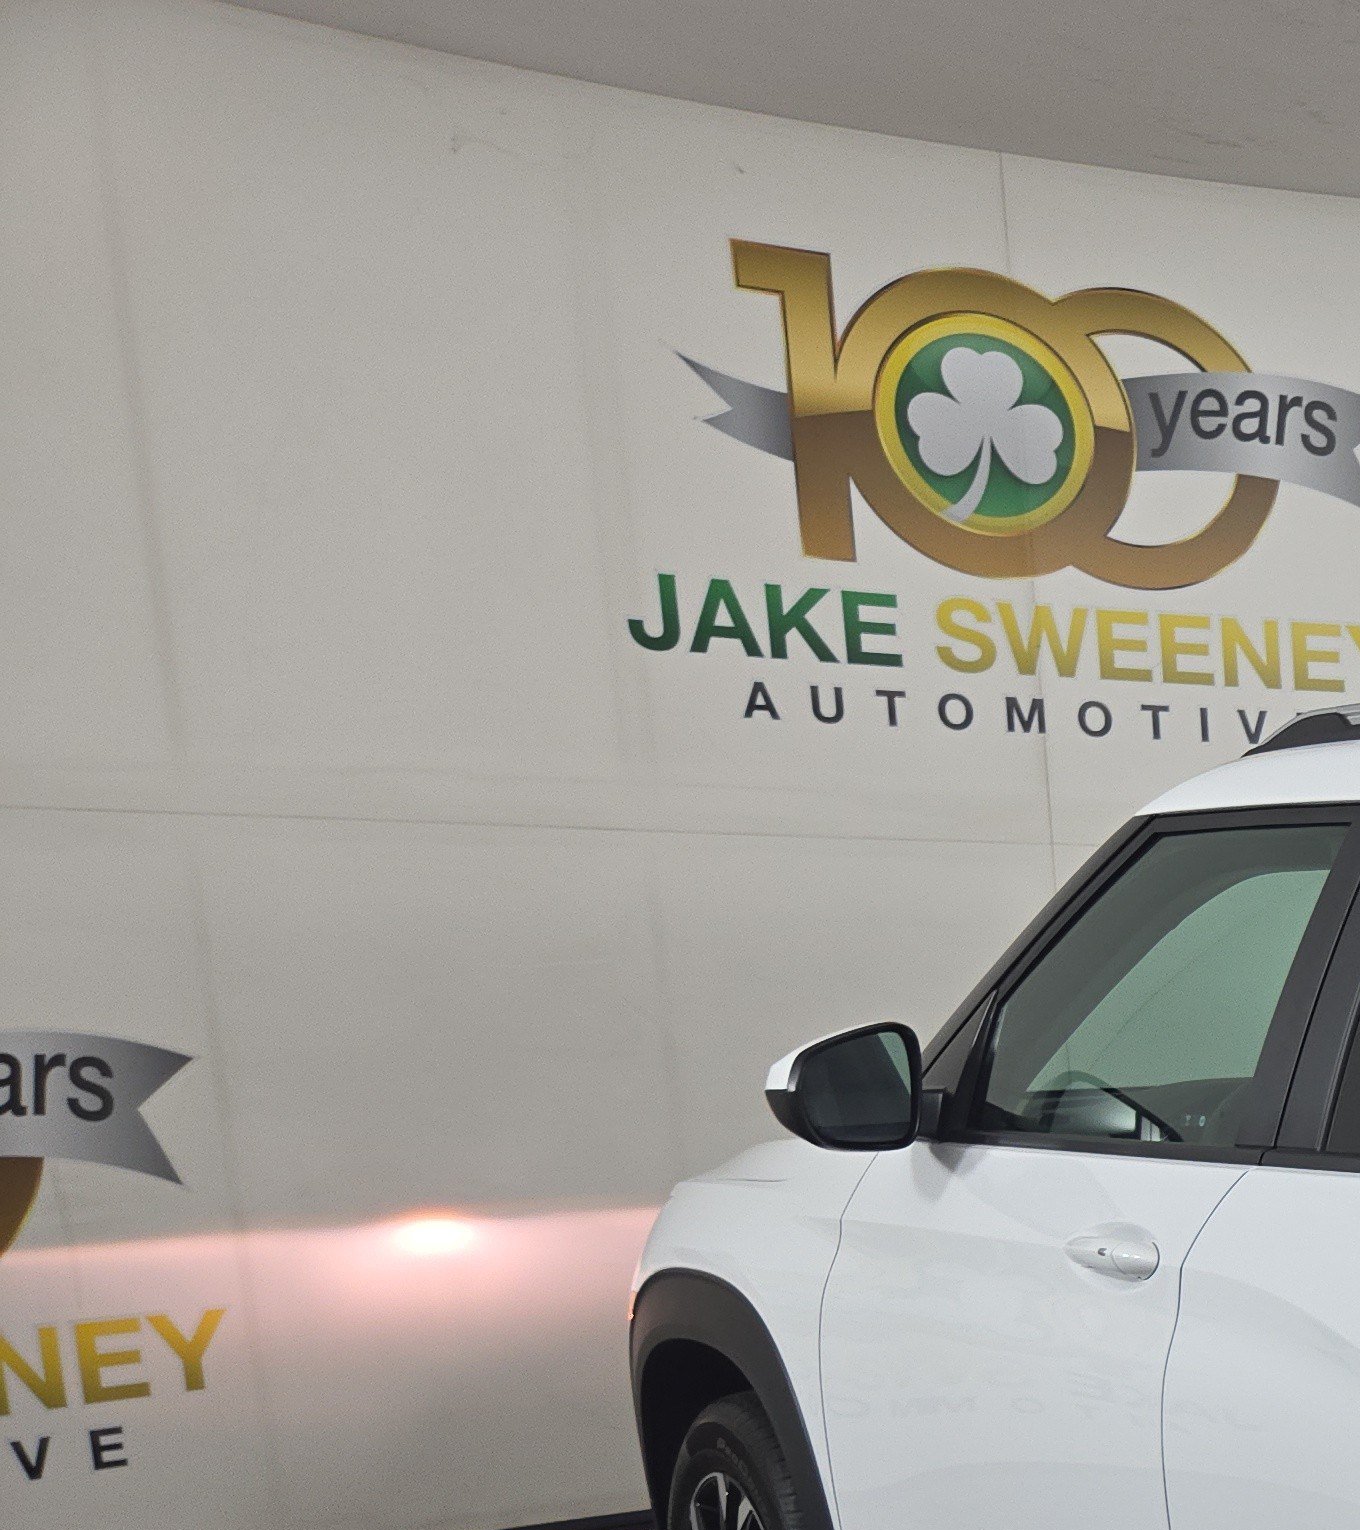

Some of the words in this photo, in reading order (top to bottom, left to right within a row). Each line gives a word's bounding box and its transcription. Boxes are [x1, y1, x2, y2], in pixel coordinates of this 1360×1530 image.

[729, 238, 1279, 590] 100
[1148, 387, 1338, 459] years
[628, 573, 904, 668] JAKE
[743, 681, 1306, 745] AUTOMOTIV
[11, 1426, 128, 1480] VE
